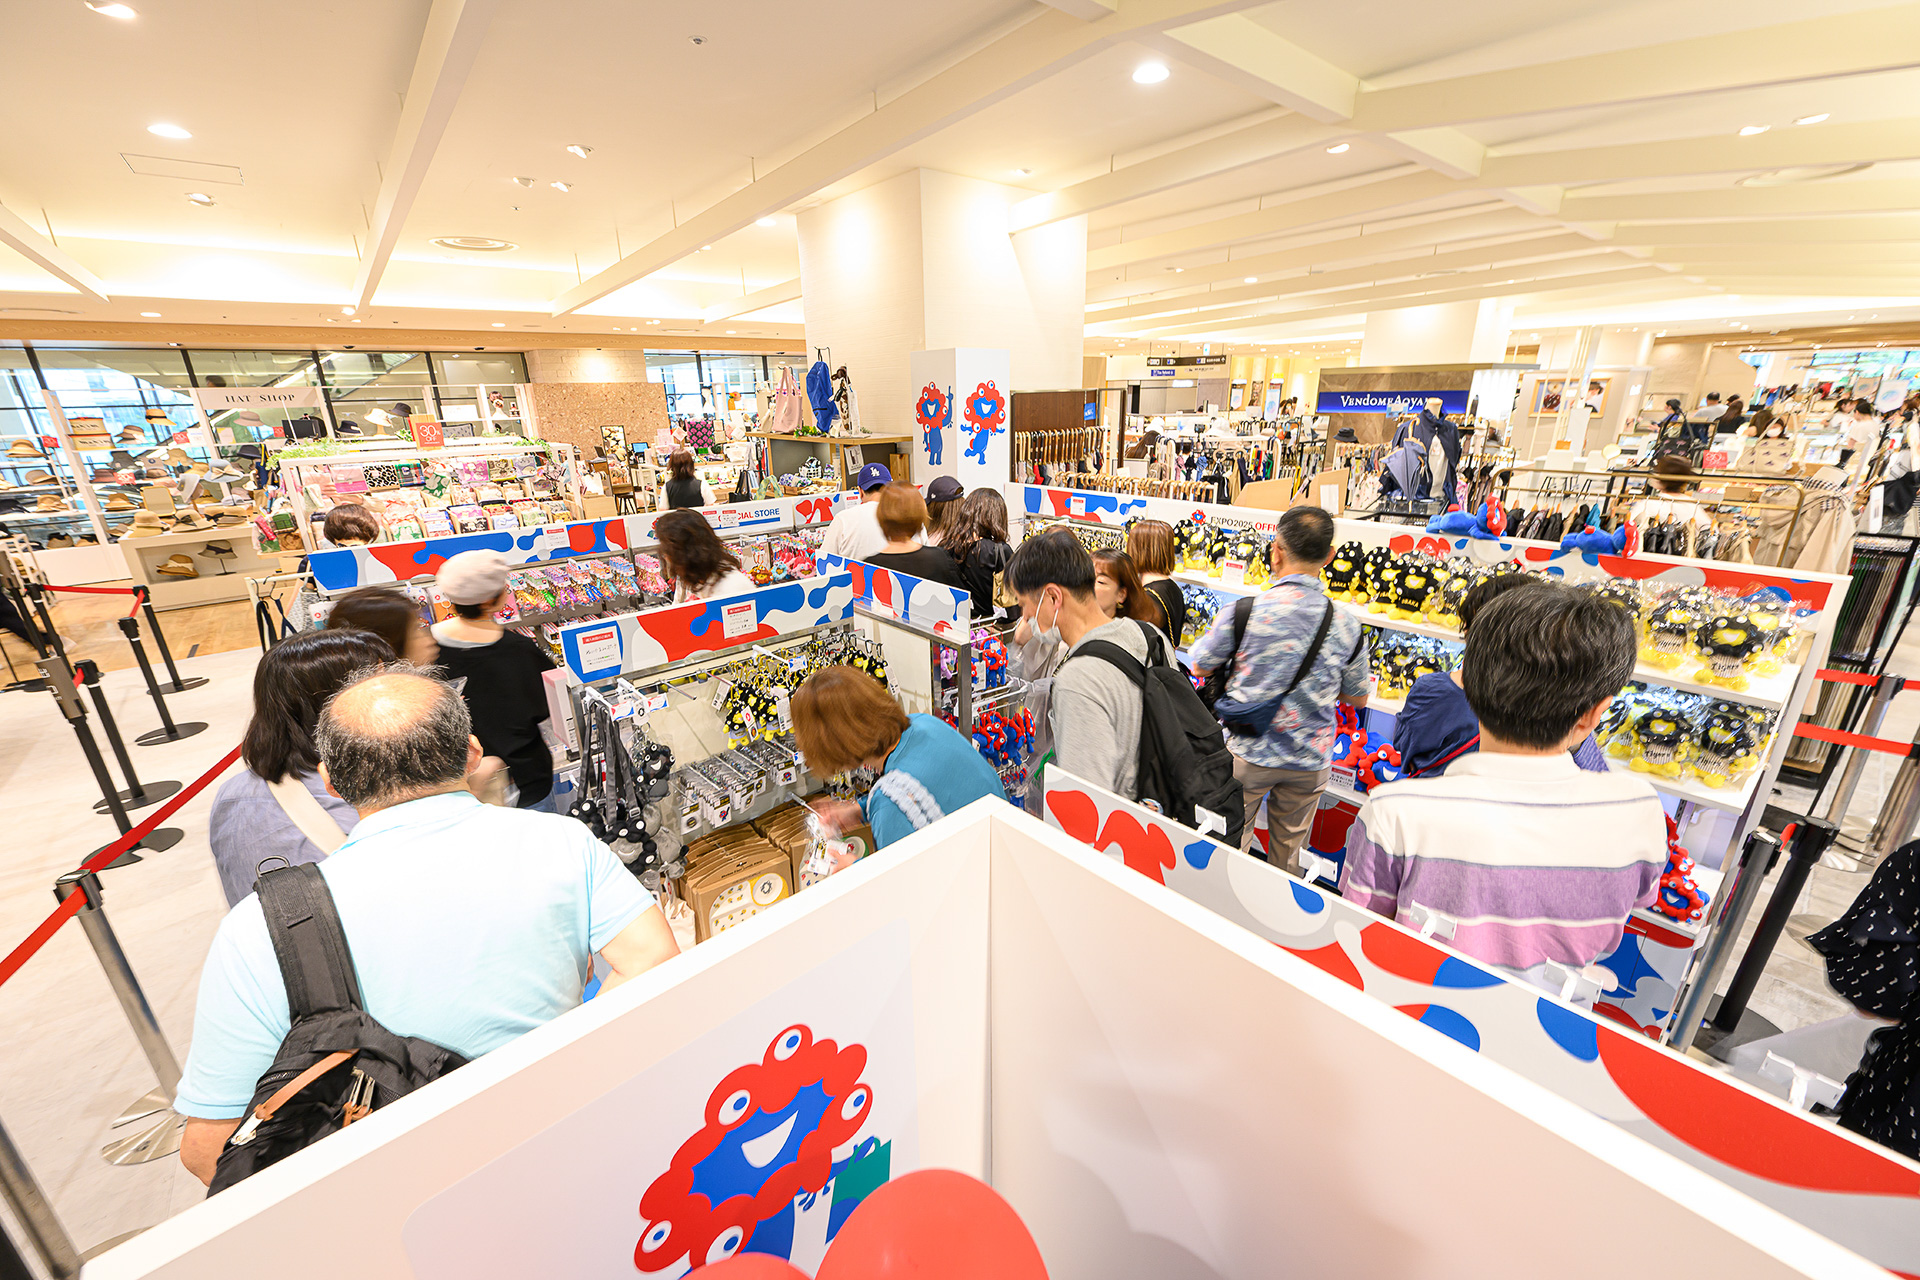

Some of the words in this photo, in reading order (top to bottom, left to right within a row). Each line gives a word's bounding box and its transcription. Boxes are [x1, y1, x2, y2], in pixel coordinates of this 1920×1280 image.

[225, 395, 251, 403] HAT
[259, 394, 295, 402] SHOP
[754, 508, 780, 518] STORE
[1210, 516, 1253, 529] EXPO2025
